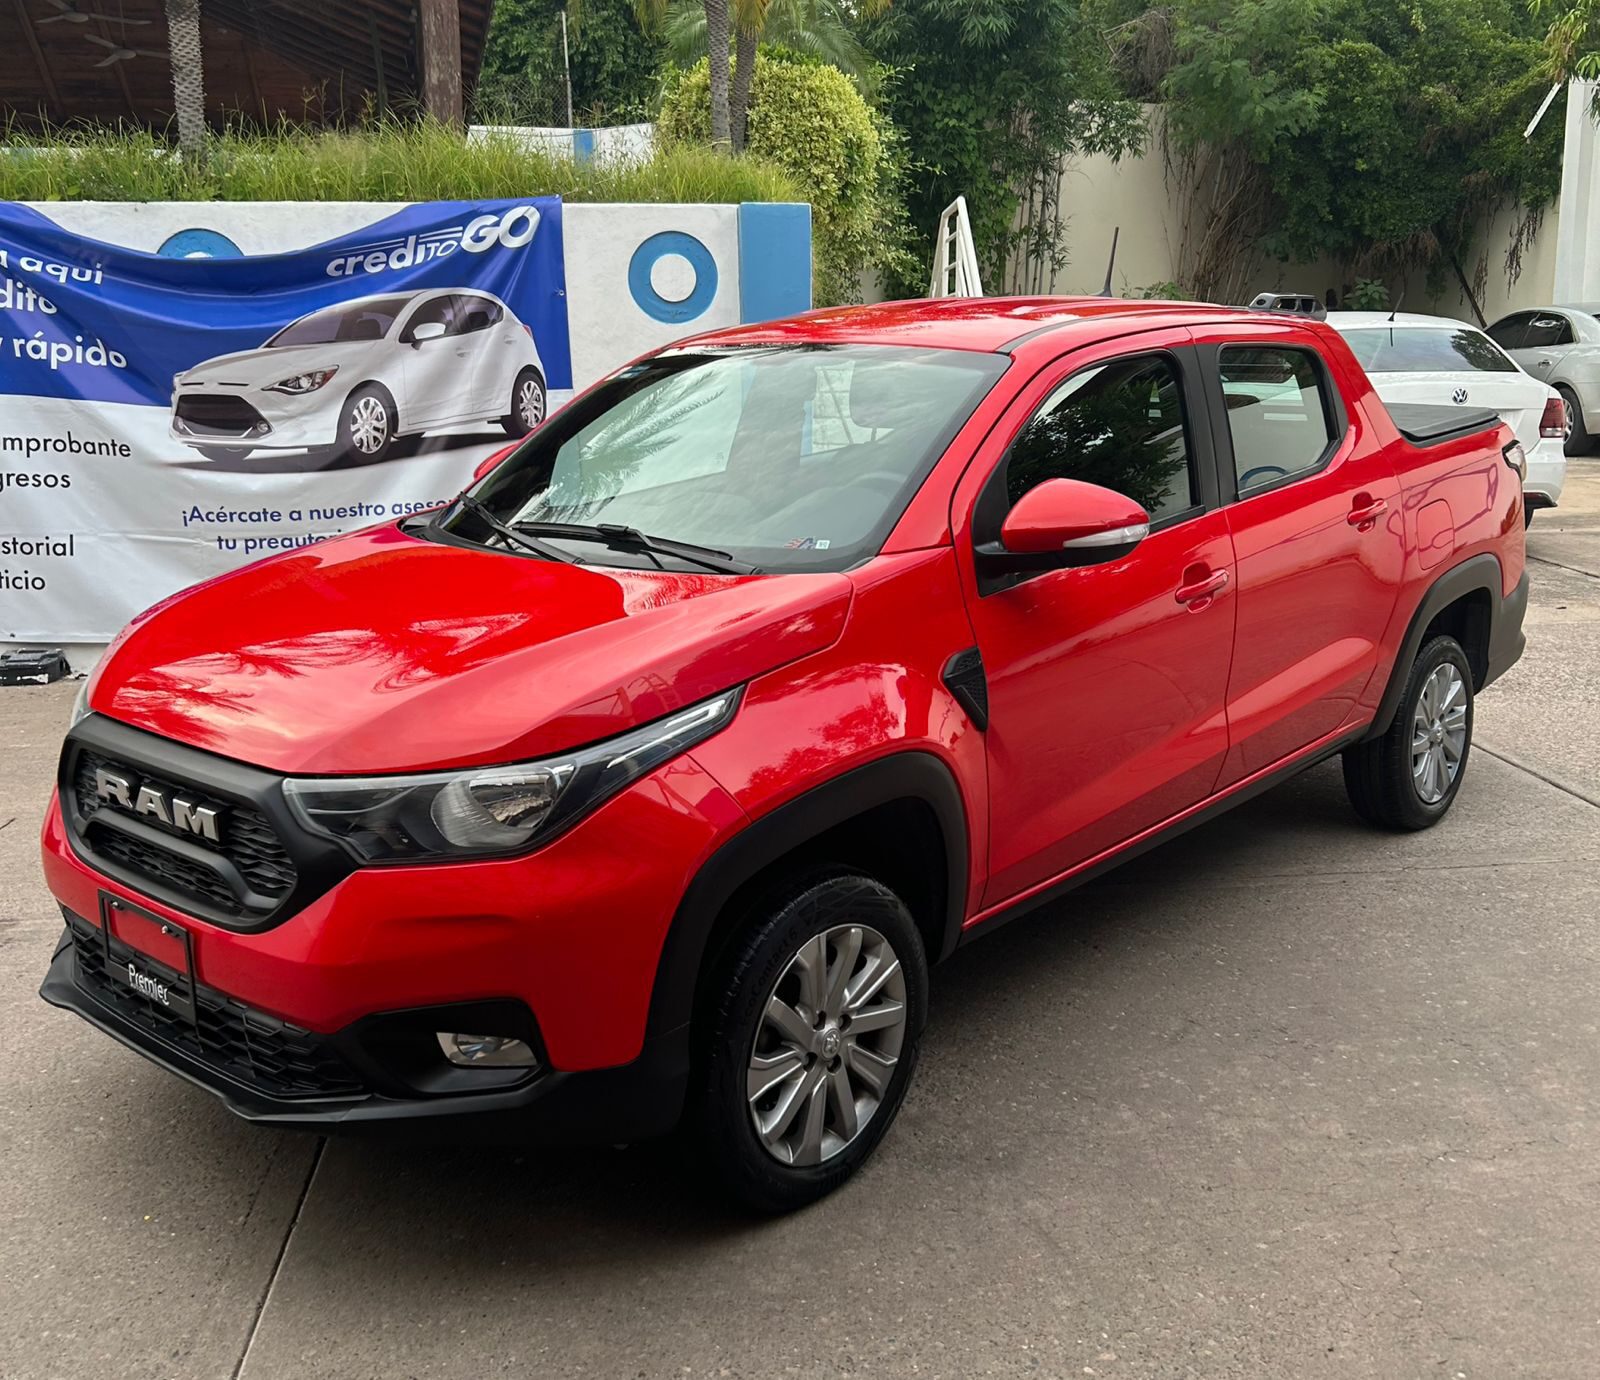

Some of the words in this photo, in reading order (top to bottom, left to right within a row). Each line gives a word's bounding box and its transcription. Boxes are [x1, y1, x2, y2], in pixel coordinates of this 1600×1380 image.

[12, 330, 127, 370] rápido
[2, 430, 131, 458] mprobante
[182, 505, 282, 527] ¡Acércate
[288, 509, 303, 521] a
[309, 502, 386, 521] nuestro
[391, 499, 452, 515] ases
[1, 533, 74, 557] storial
[217, 535, 237, 550] tu
[96, 768, 220, 842] RAM
[128, 963, 169, 1006] Premier
